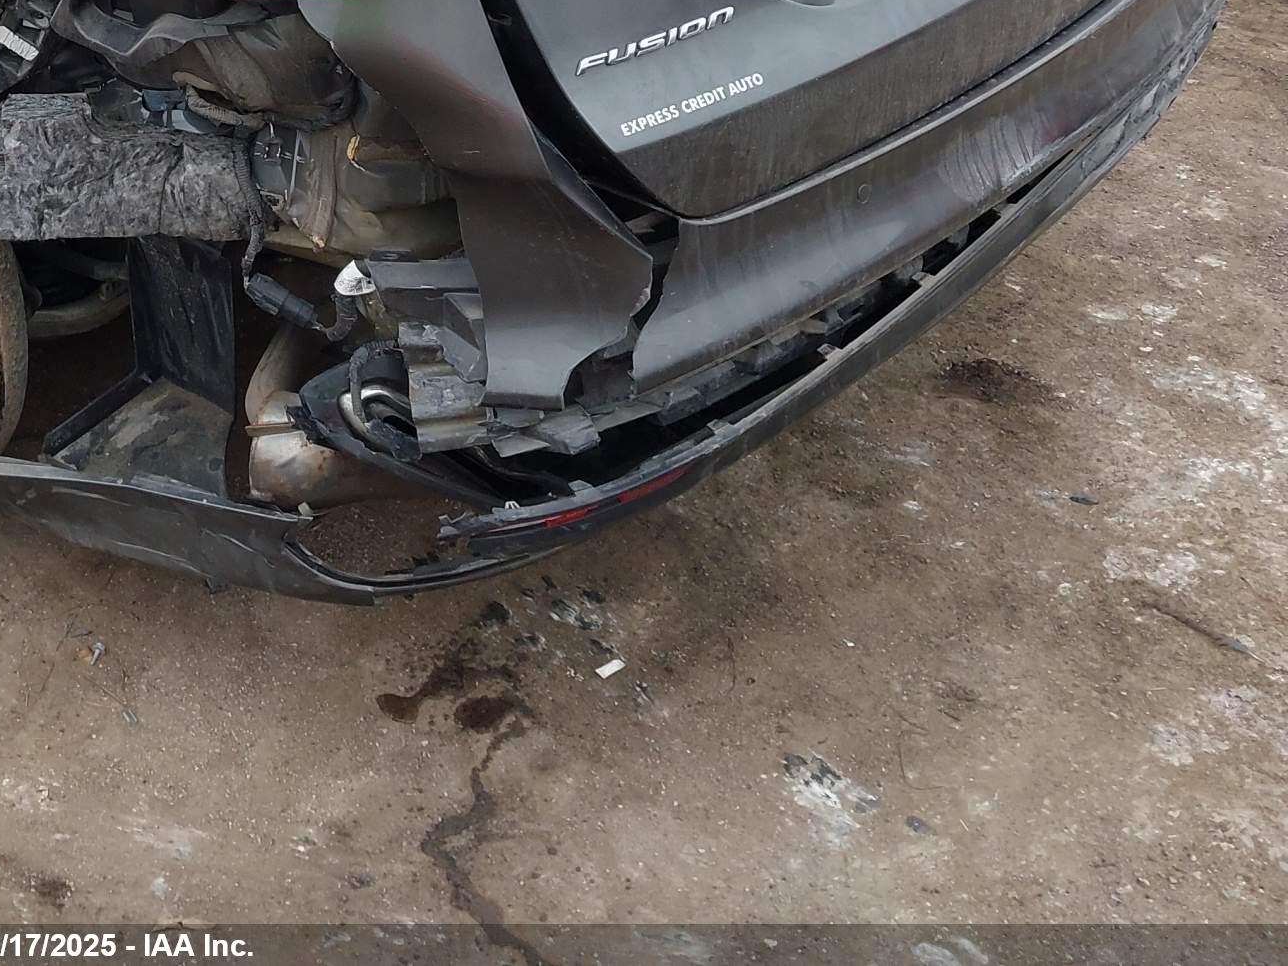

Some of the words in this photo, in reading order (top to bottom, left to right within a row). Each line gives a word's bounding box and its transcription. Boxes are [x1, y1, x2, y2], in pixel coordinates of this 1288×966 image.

[575, 5, 735, 76] FUSION
[620, 104, 680, 137] EXPRESS
[681, 86, 726, 114] CREDIT
[728, 72, 764, 97] AUTO
